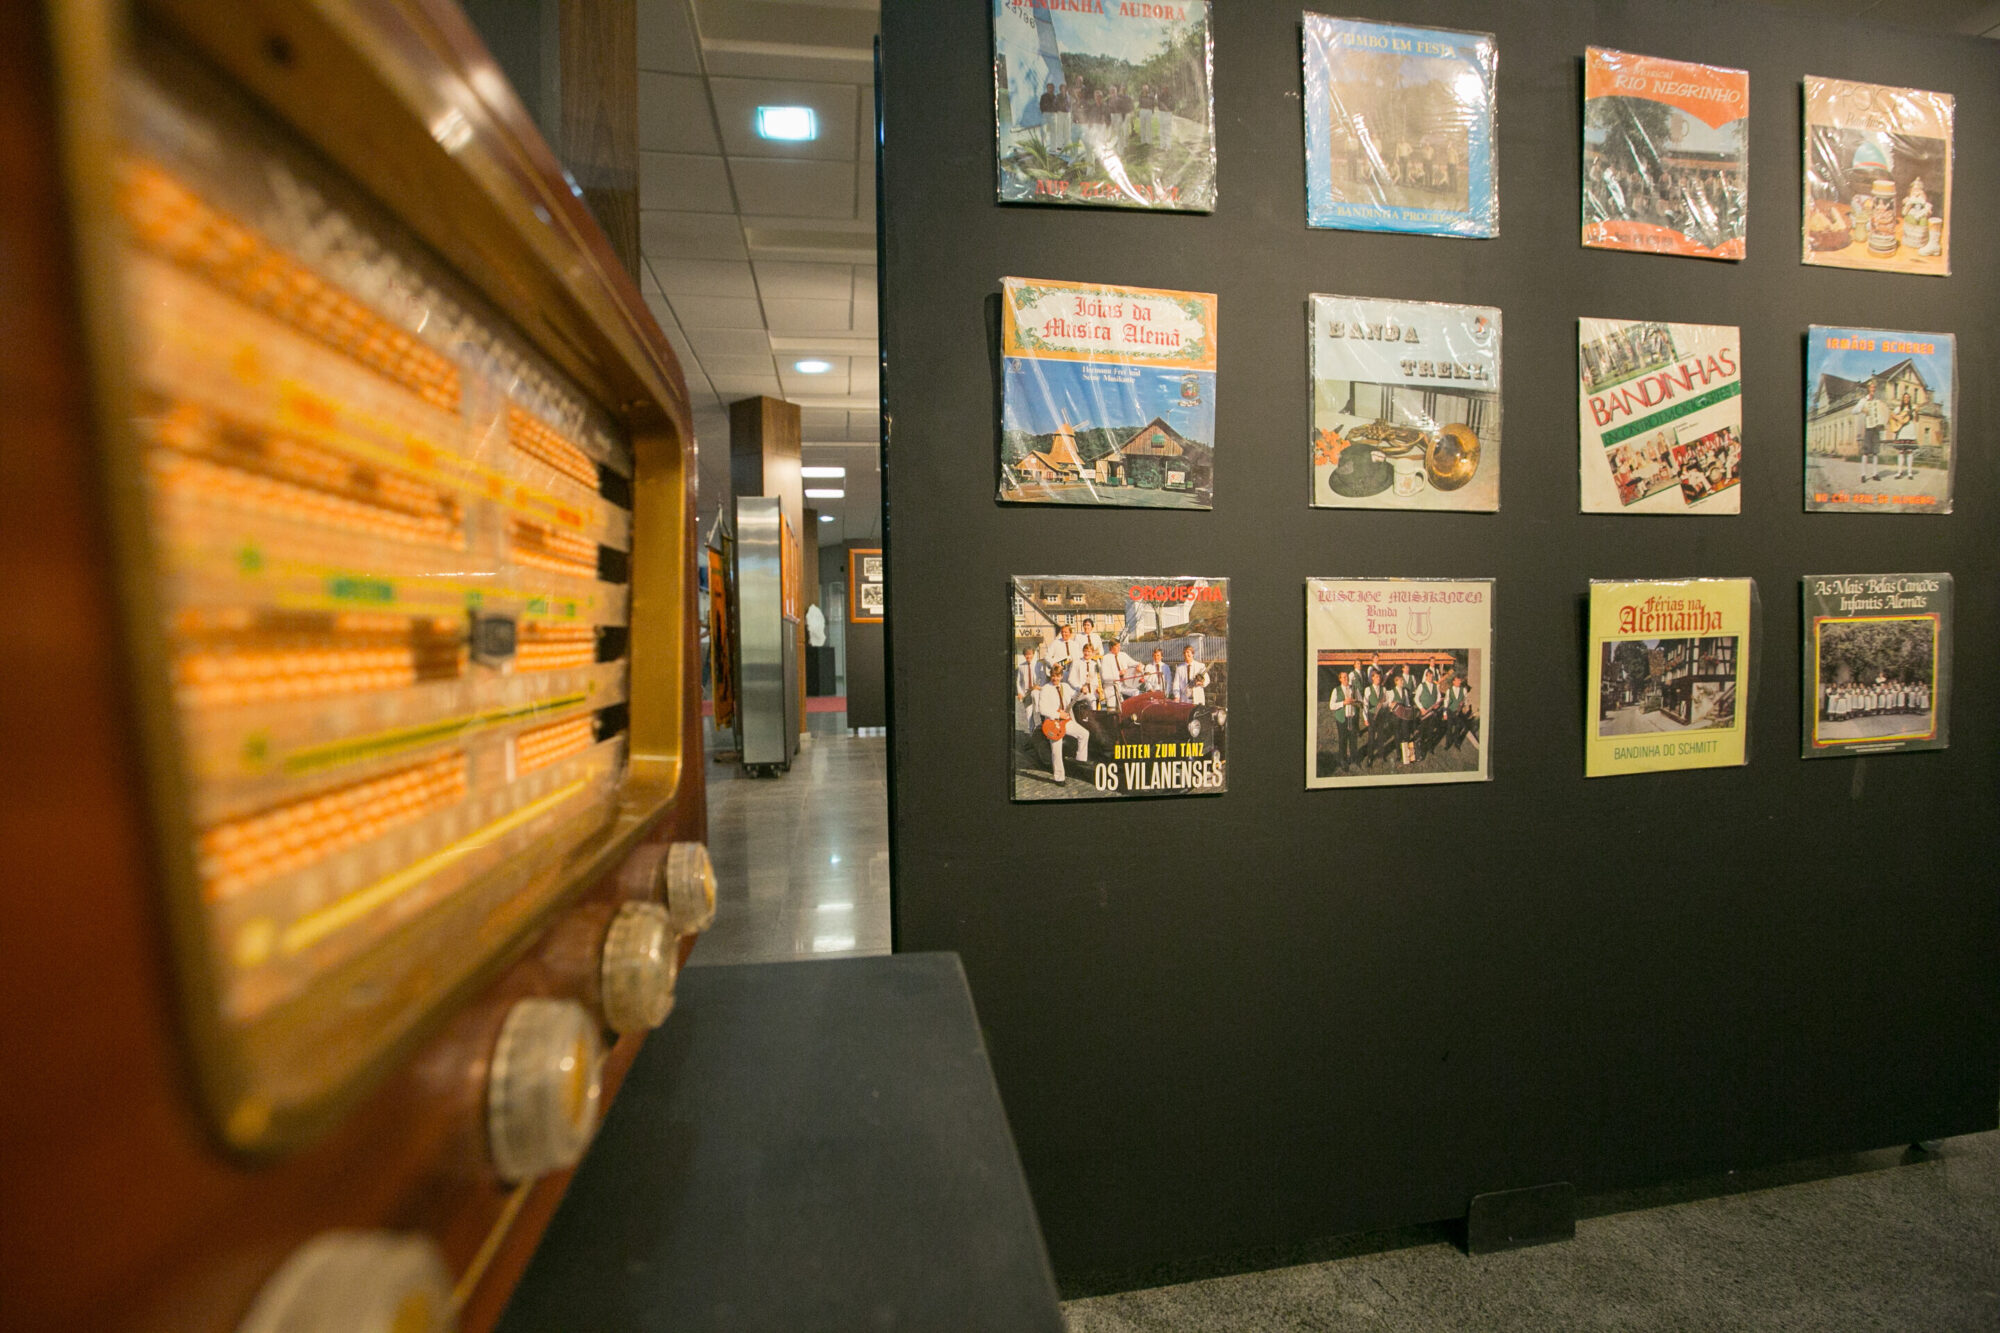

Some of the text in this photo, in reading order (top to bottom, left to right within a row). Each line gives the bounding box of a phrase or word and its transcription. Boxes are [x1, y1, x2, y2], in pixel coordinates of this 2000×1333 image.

[1119, 3, 1187, 22] AURORA
[1343, 33, 1457, 58] TIMBÓ EM FESTA
[1614, 75, 1741, 103] RIO NEGRINHO
[1034, 179, 1069, 195] AUF
[1134, 184, 1181, 201] TAZ
[1337, 206, 1399, 221] BANDINHA
[1132, 303, 1152, 321] da
[1042, 318, 1181, 347] Música Alemã
[1329, 320, 1420, 344] BANDA
[1826, 335, 1935, 355] IRMÃOS SCHERER
[1588, 347, 1737, 427] BANDINHAS
[1129, 585, 1224, 602] ORQUESTRA
[1814, 577, 1940, 595] As Mais Belas Canções
[1317, 590, 1483, 604] LUSTIGE MUSIKANTEN
[1644, 595, 1701, 613] Férias na
[1840, 593, 1927, 617] Infantis Alemãs
[1366, 605, 1398, 618] Banda
[1618, 605, 1723, 635] Alemanha
[1367, 619, 1397, 635] Lyra
[1114, 742, 1204, 760] BITTEN ZUM TANZ
[1614, 740, 1719, 760] BANDINHA DO SCHMITT
[1095, 759, 1224, 791] OS VILANENSES
